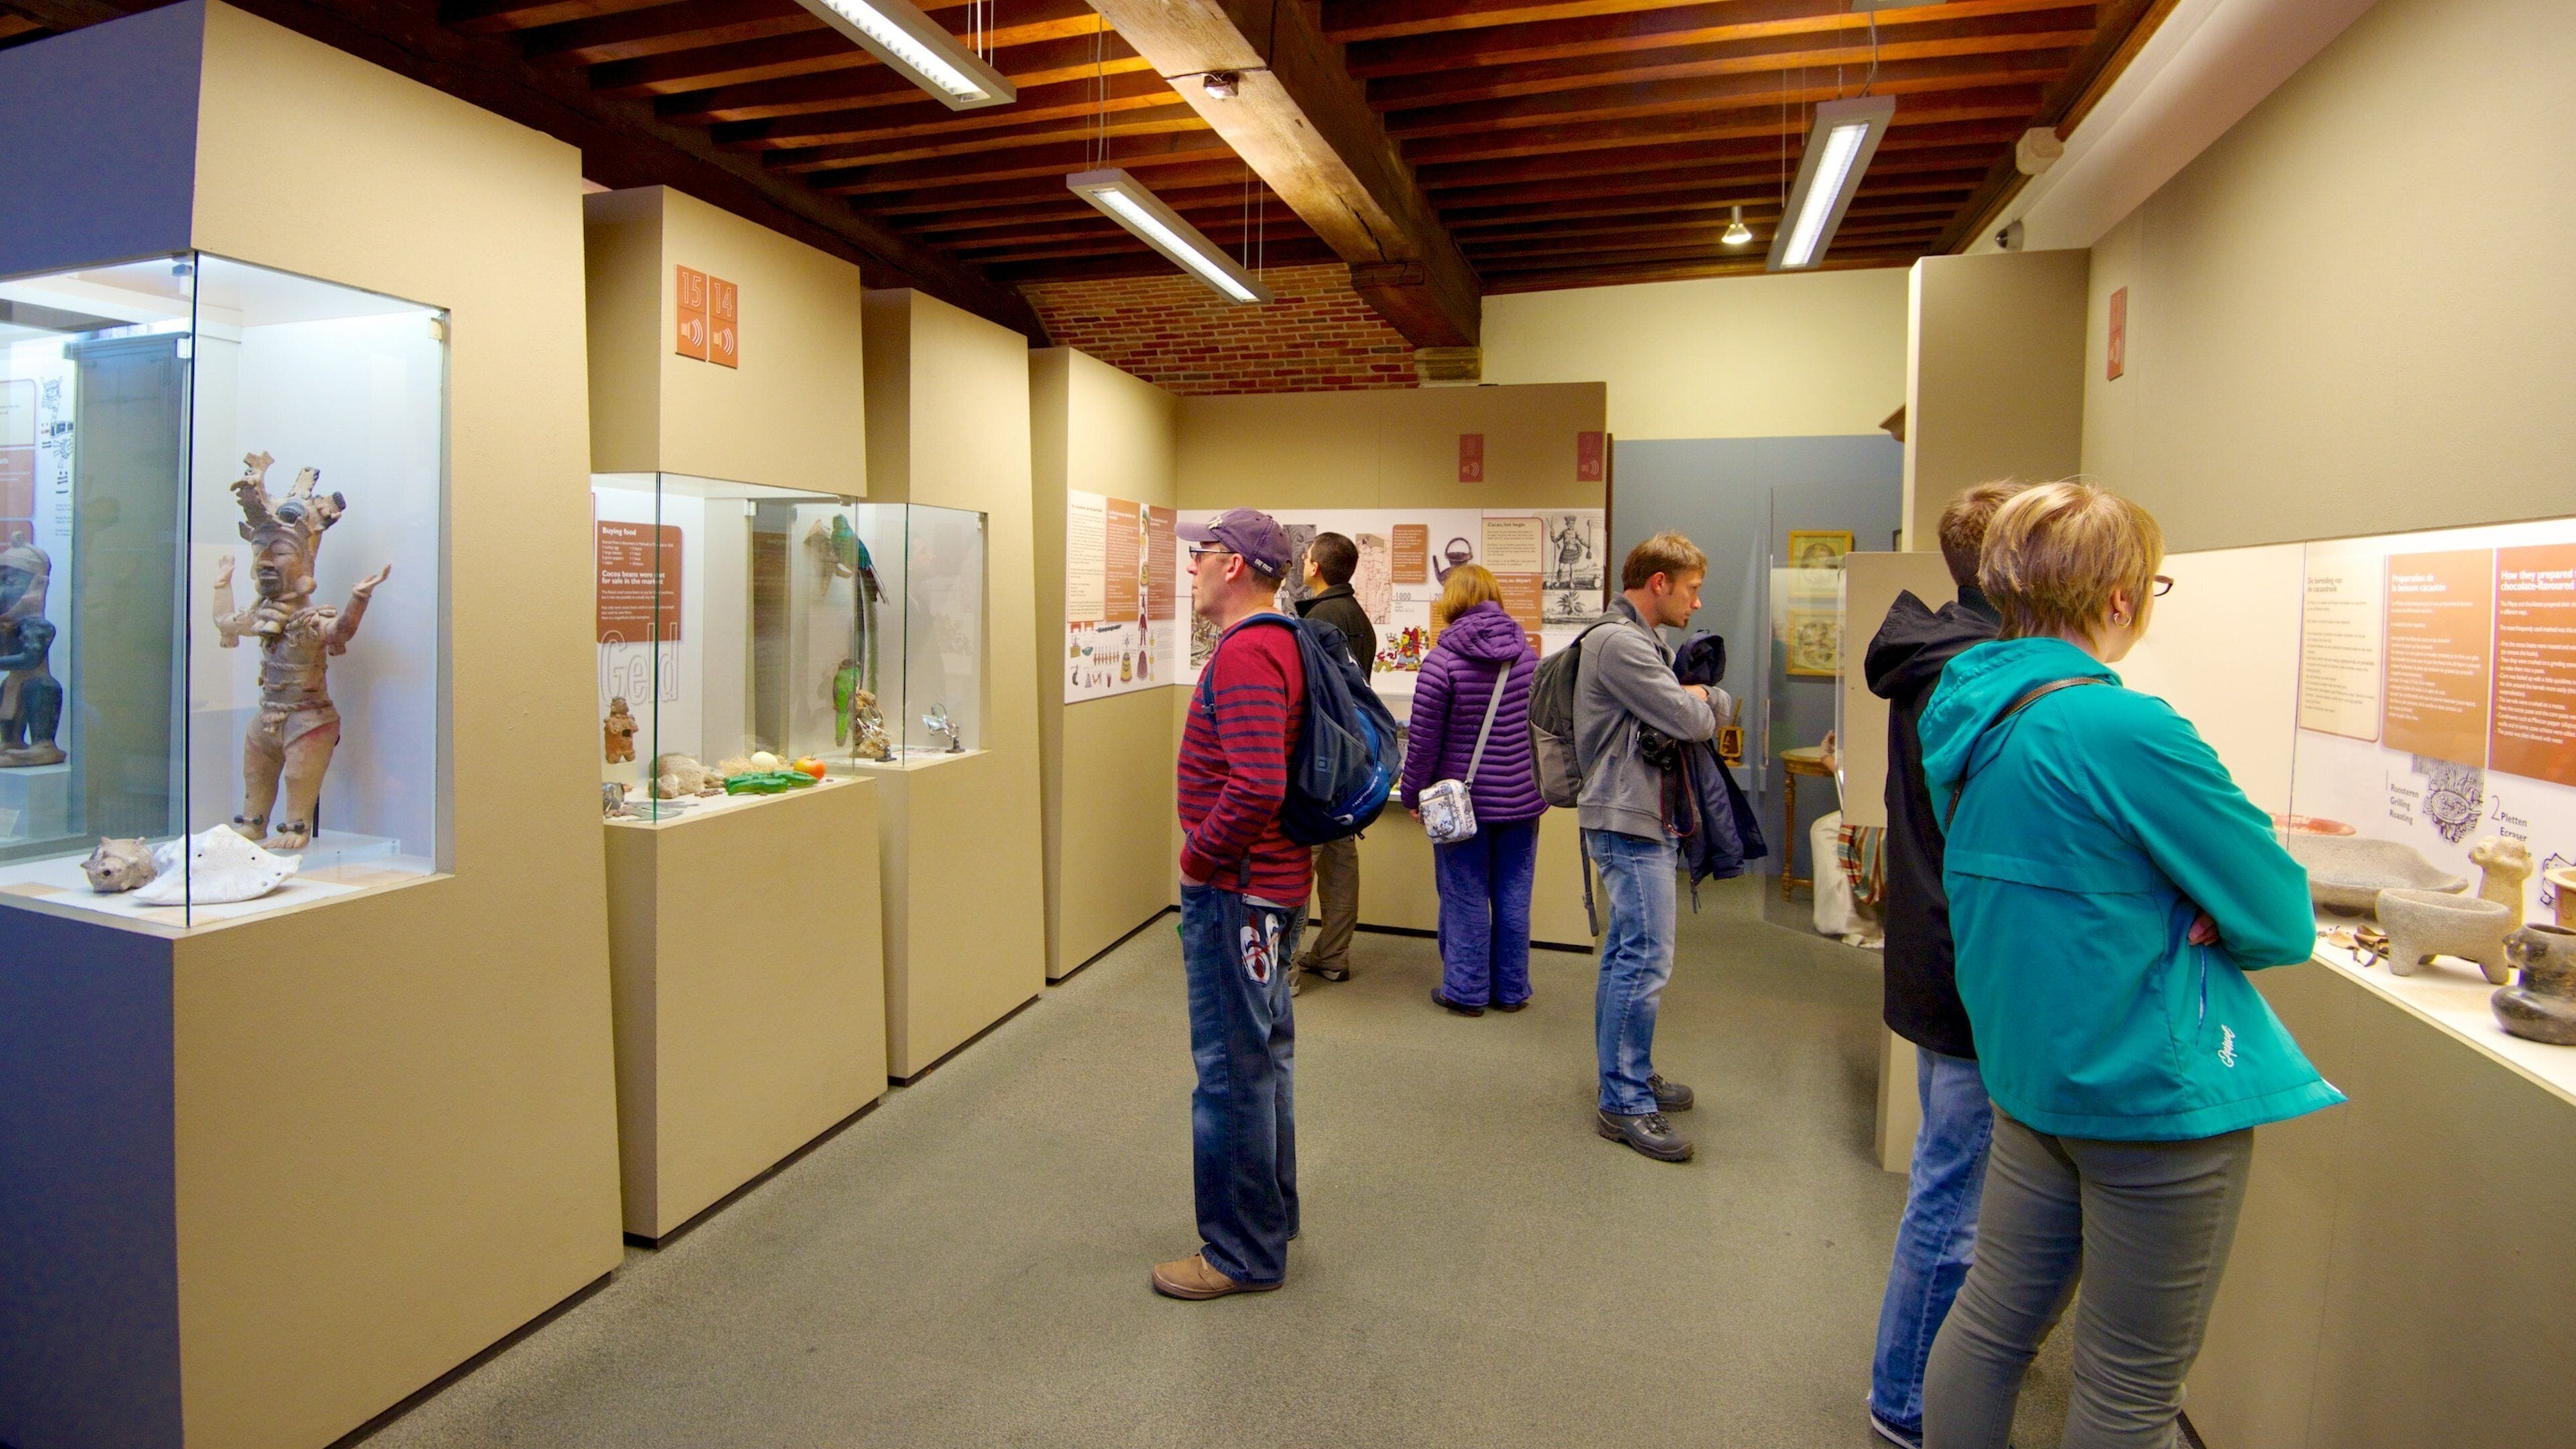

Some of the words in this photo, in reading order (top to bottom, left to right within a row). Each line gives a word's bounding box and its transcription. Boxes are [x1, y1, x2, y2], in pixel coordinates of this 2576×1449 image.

[682, 271, 702, 308] 15
[714, 282, 733, 317] 14
[602, 526, 623, 537] Buying
[623, 528, 637, 536] food
[602, 570, 621, 578] Cocoa
[2500, 570, 2518, 580] How
[2519, 570, 2536, 582] they
[2536, 568, 2573, 582] prepared
[600, 621, 679, 708] Geld
[2390, 783, 2419, 799] Roosteren
[2390, 796, 2412, 811] Grilling
[2491, 795, 2500, 821] 2
[2500, 812, 2528, 827] Pletten
[2389, 809, 2414, 826] Roasting
[2500, 826, 2528, 843] Ecraser
